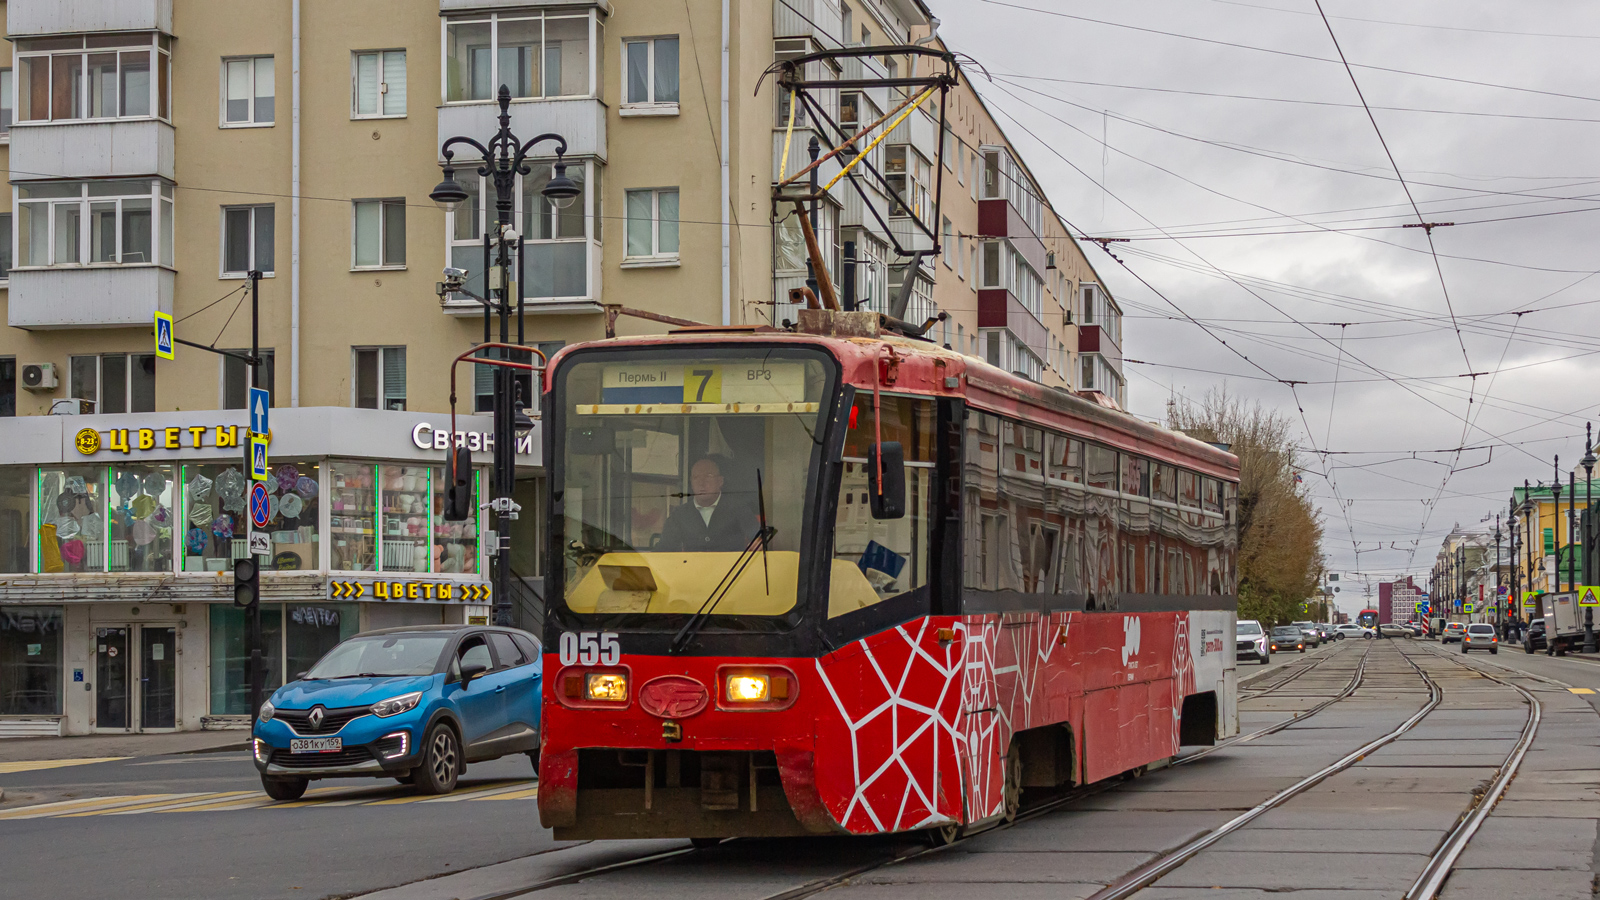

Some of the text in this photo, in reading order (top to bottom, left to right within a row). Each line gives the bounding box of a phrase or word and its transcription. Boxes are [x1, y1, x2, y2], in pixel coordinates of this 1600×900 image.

[619, 372, 656, 384] Пермь
[692, 369, 713, 402] 7
[109, 425, 239, 454] ЦВЕТЫ
[411, 422, 532, 454] Связнй
[373, 581, 452, 600] ЦВЕТЫ
[559, 631, 621, 666] 055
